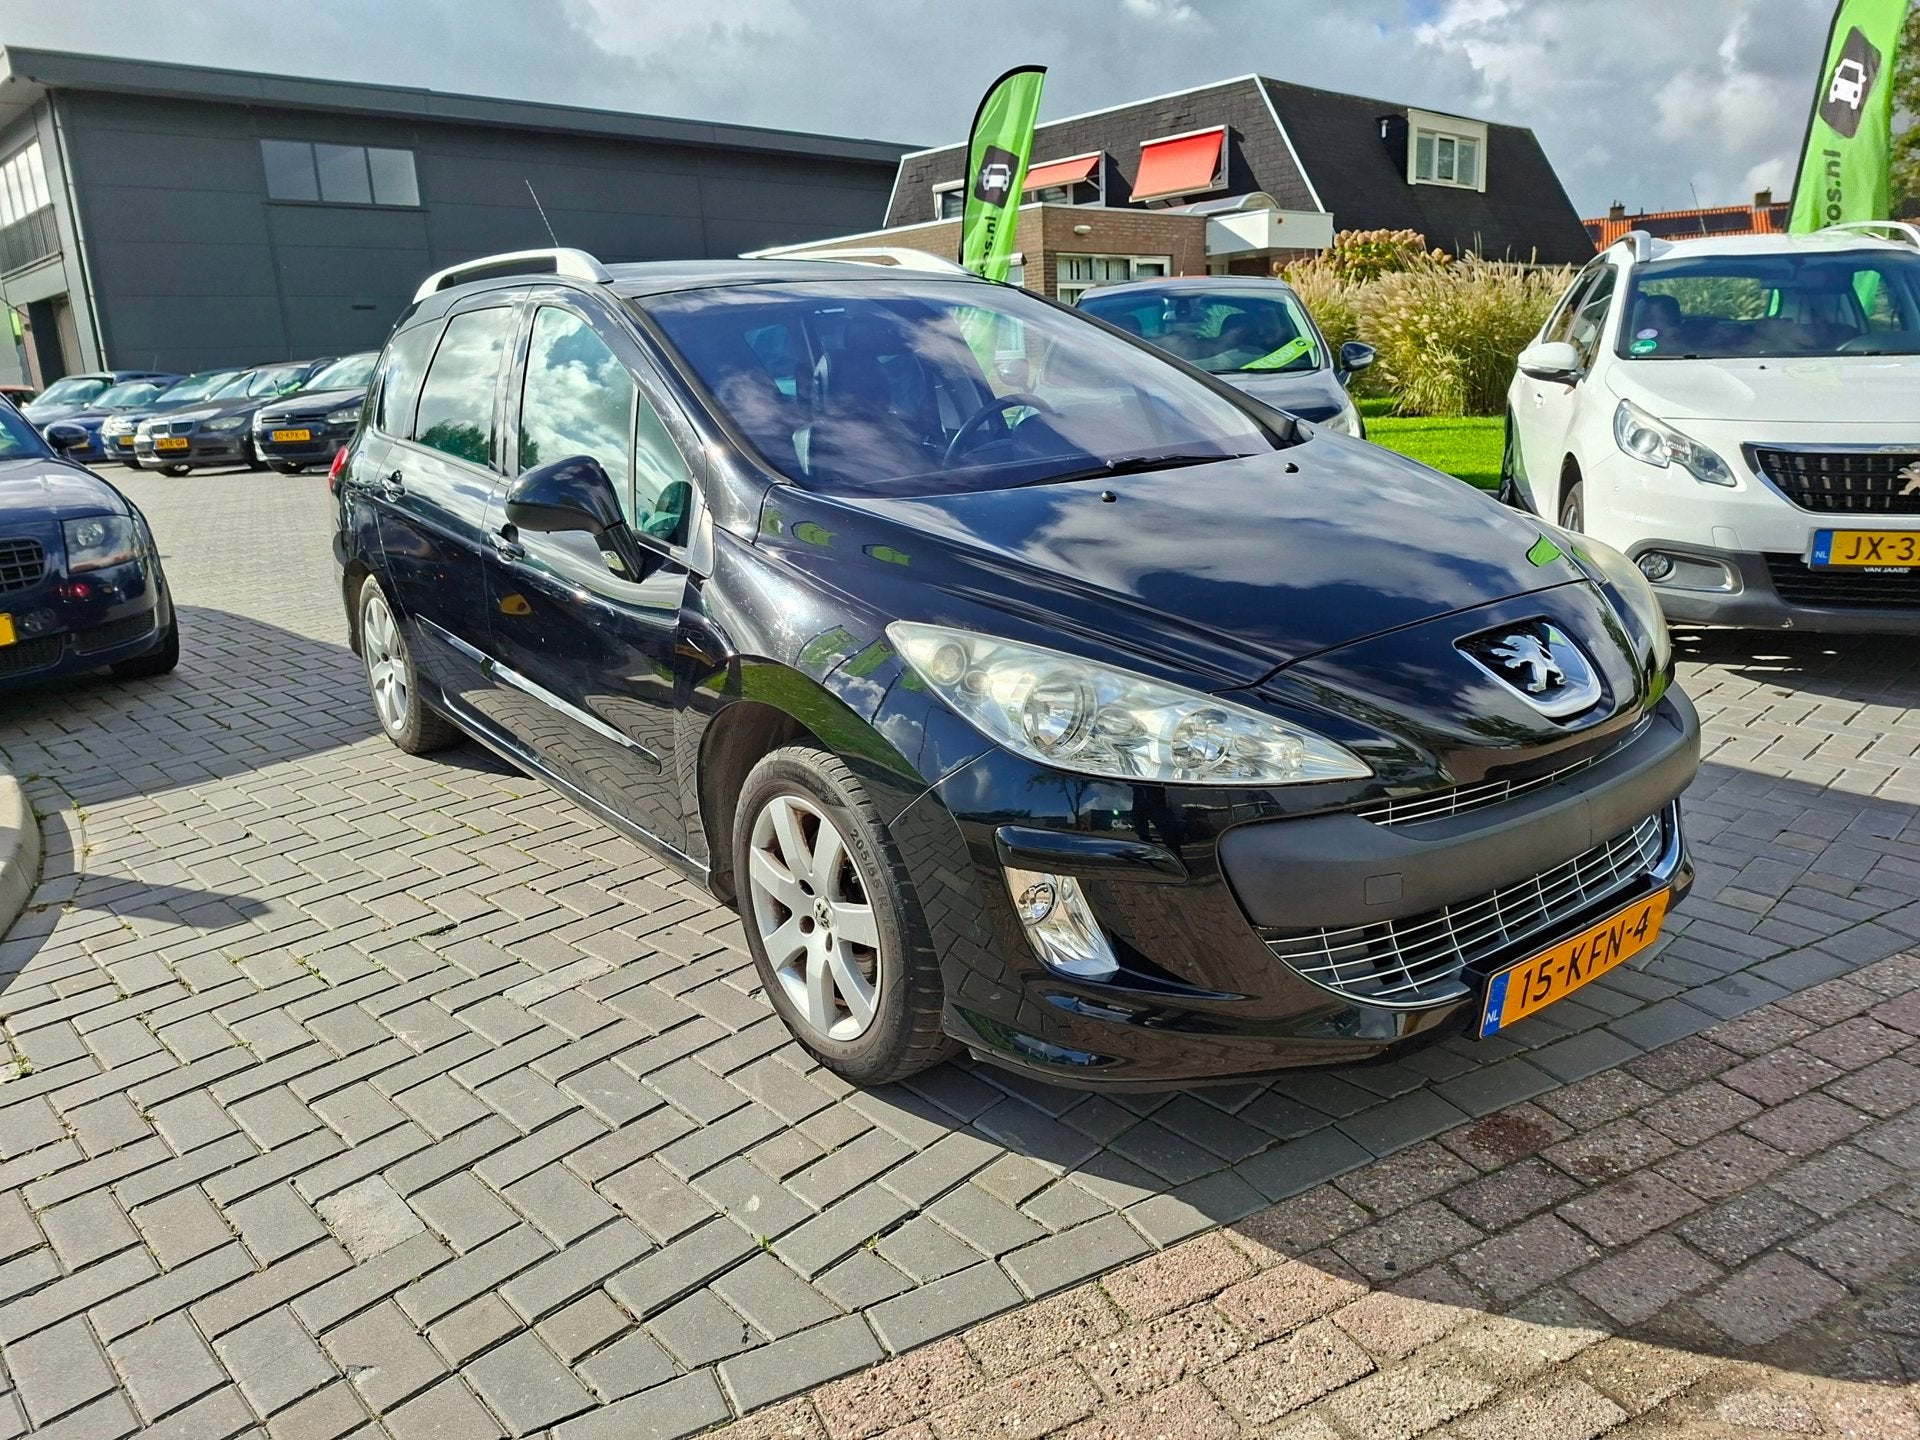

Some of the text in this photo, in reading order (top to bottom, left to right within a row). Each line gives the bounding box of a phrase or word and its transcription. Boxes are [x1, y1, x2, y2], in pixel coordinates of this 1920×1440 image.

[1814, 551, 1828, 559] NL
[1845, 536, 1920, 561] JX-3
[849, 828, 883, 889] 205/55
[1521, 905, 1651, 1009] 15-KFN-4
[1486, 1010, 1499, 1024] NL
